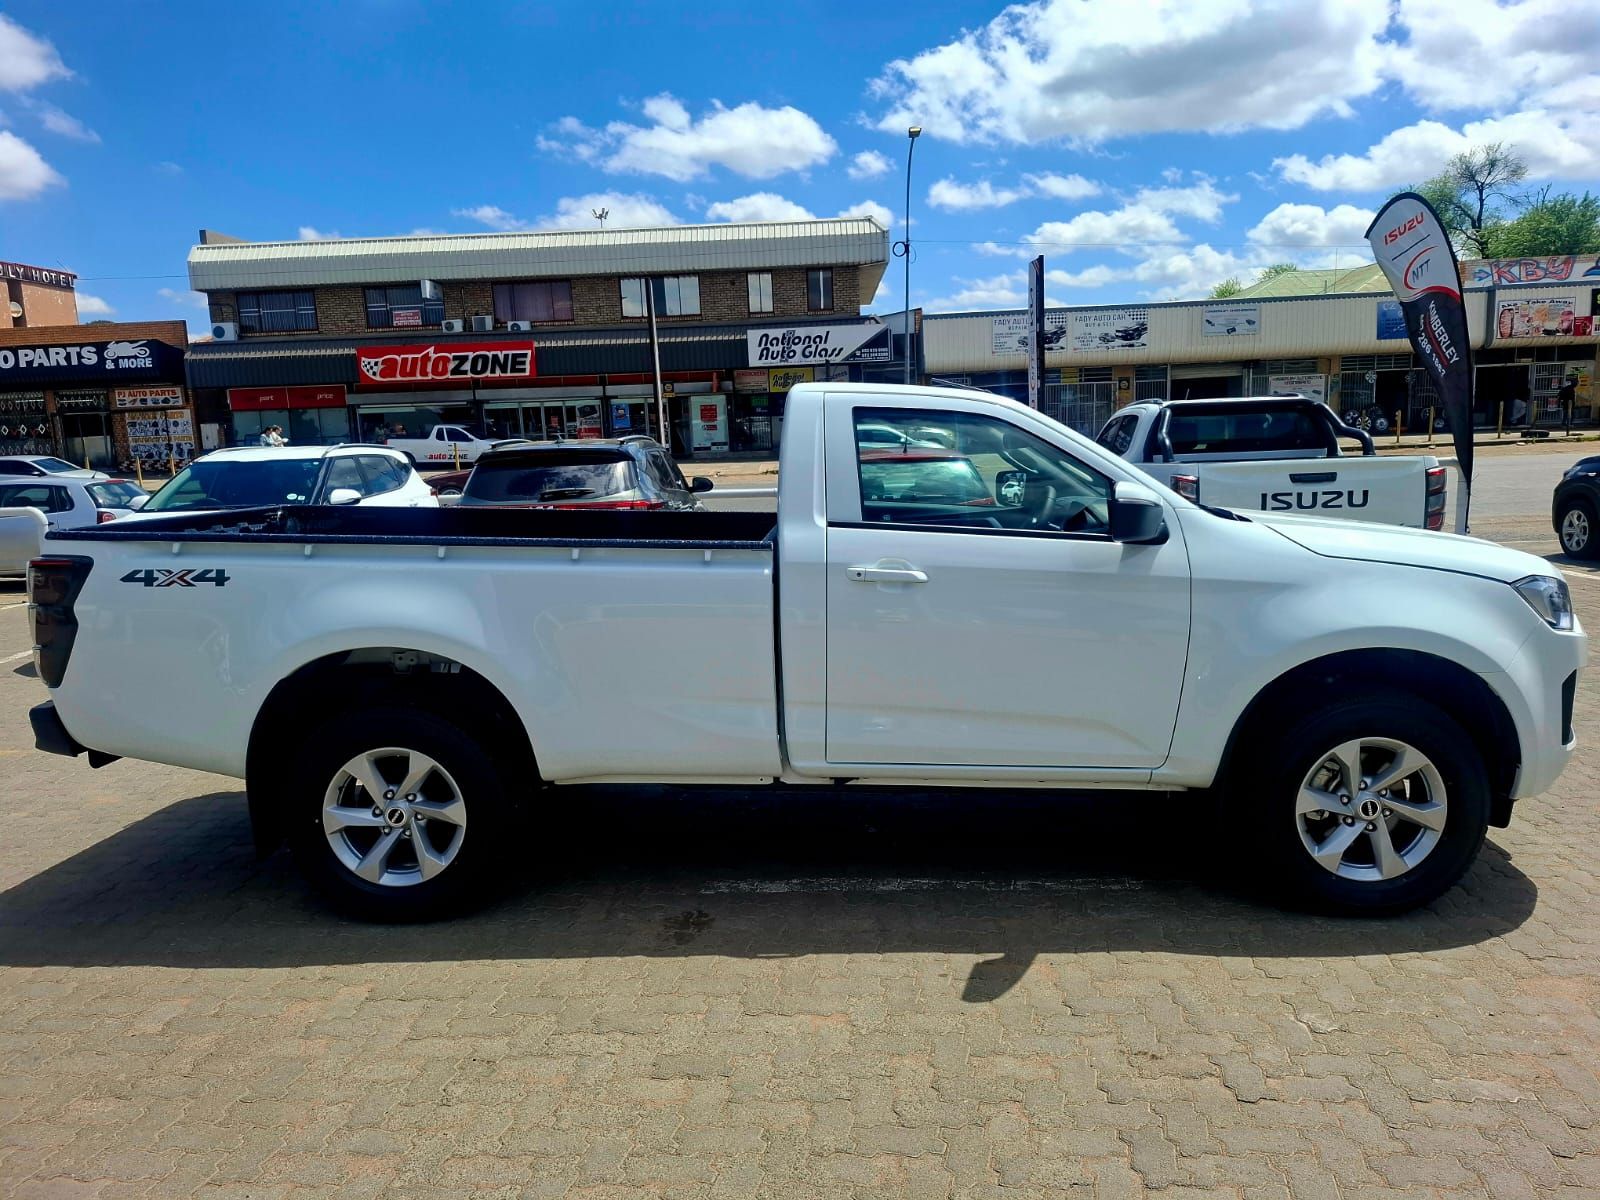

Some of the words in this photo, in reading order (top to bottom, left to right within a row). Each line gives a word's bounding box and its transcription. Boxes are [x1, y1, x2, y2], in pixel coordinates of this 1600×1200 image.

[1384, 211, 1424, 246] ISUZU
[32, 269, 76, 288] HOTEL
[1411, 258, 1431, 283] NTT
[1093, 314, 1111, 322] AUTO
[758, 330, 829, 349] National
[1428, 300, 1460, 364] KIMBERLEY
[18, 347, 97, 367] PARTS
[758, 346, 796, 361] Auto
[801, 345, 844, 359] Glass
[105, 360, 115, 369] &
[118, 358, 152, 368] MORE
[128, 390, 147, 398] AUTO
[149, 389, 177, 397] PARTS
[1261, 490, 1369, 510] ISUZU
[120, 569, 230, 587] 4X4
